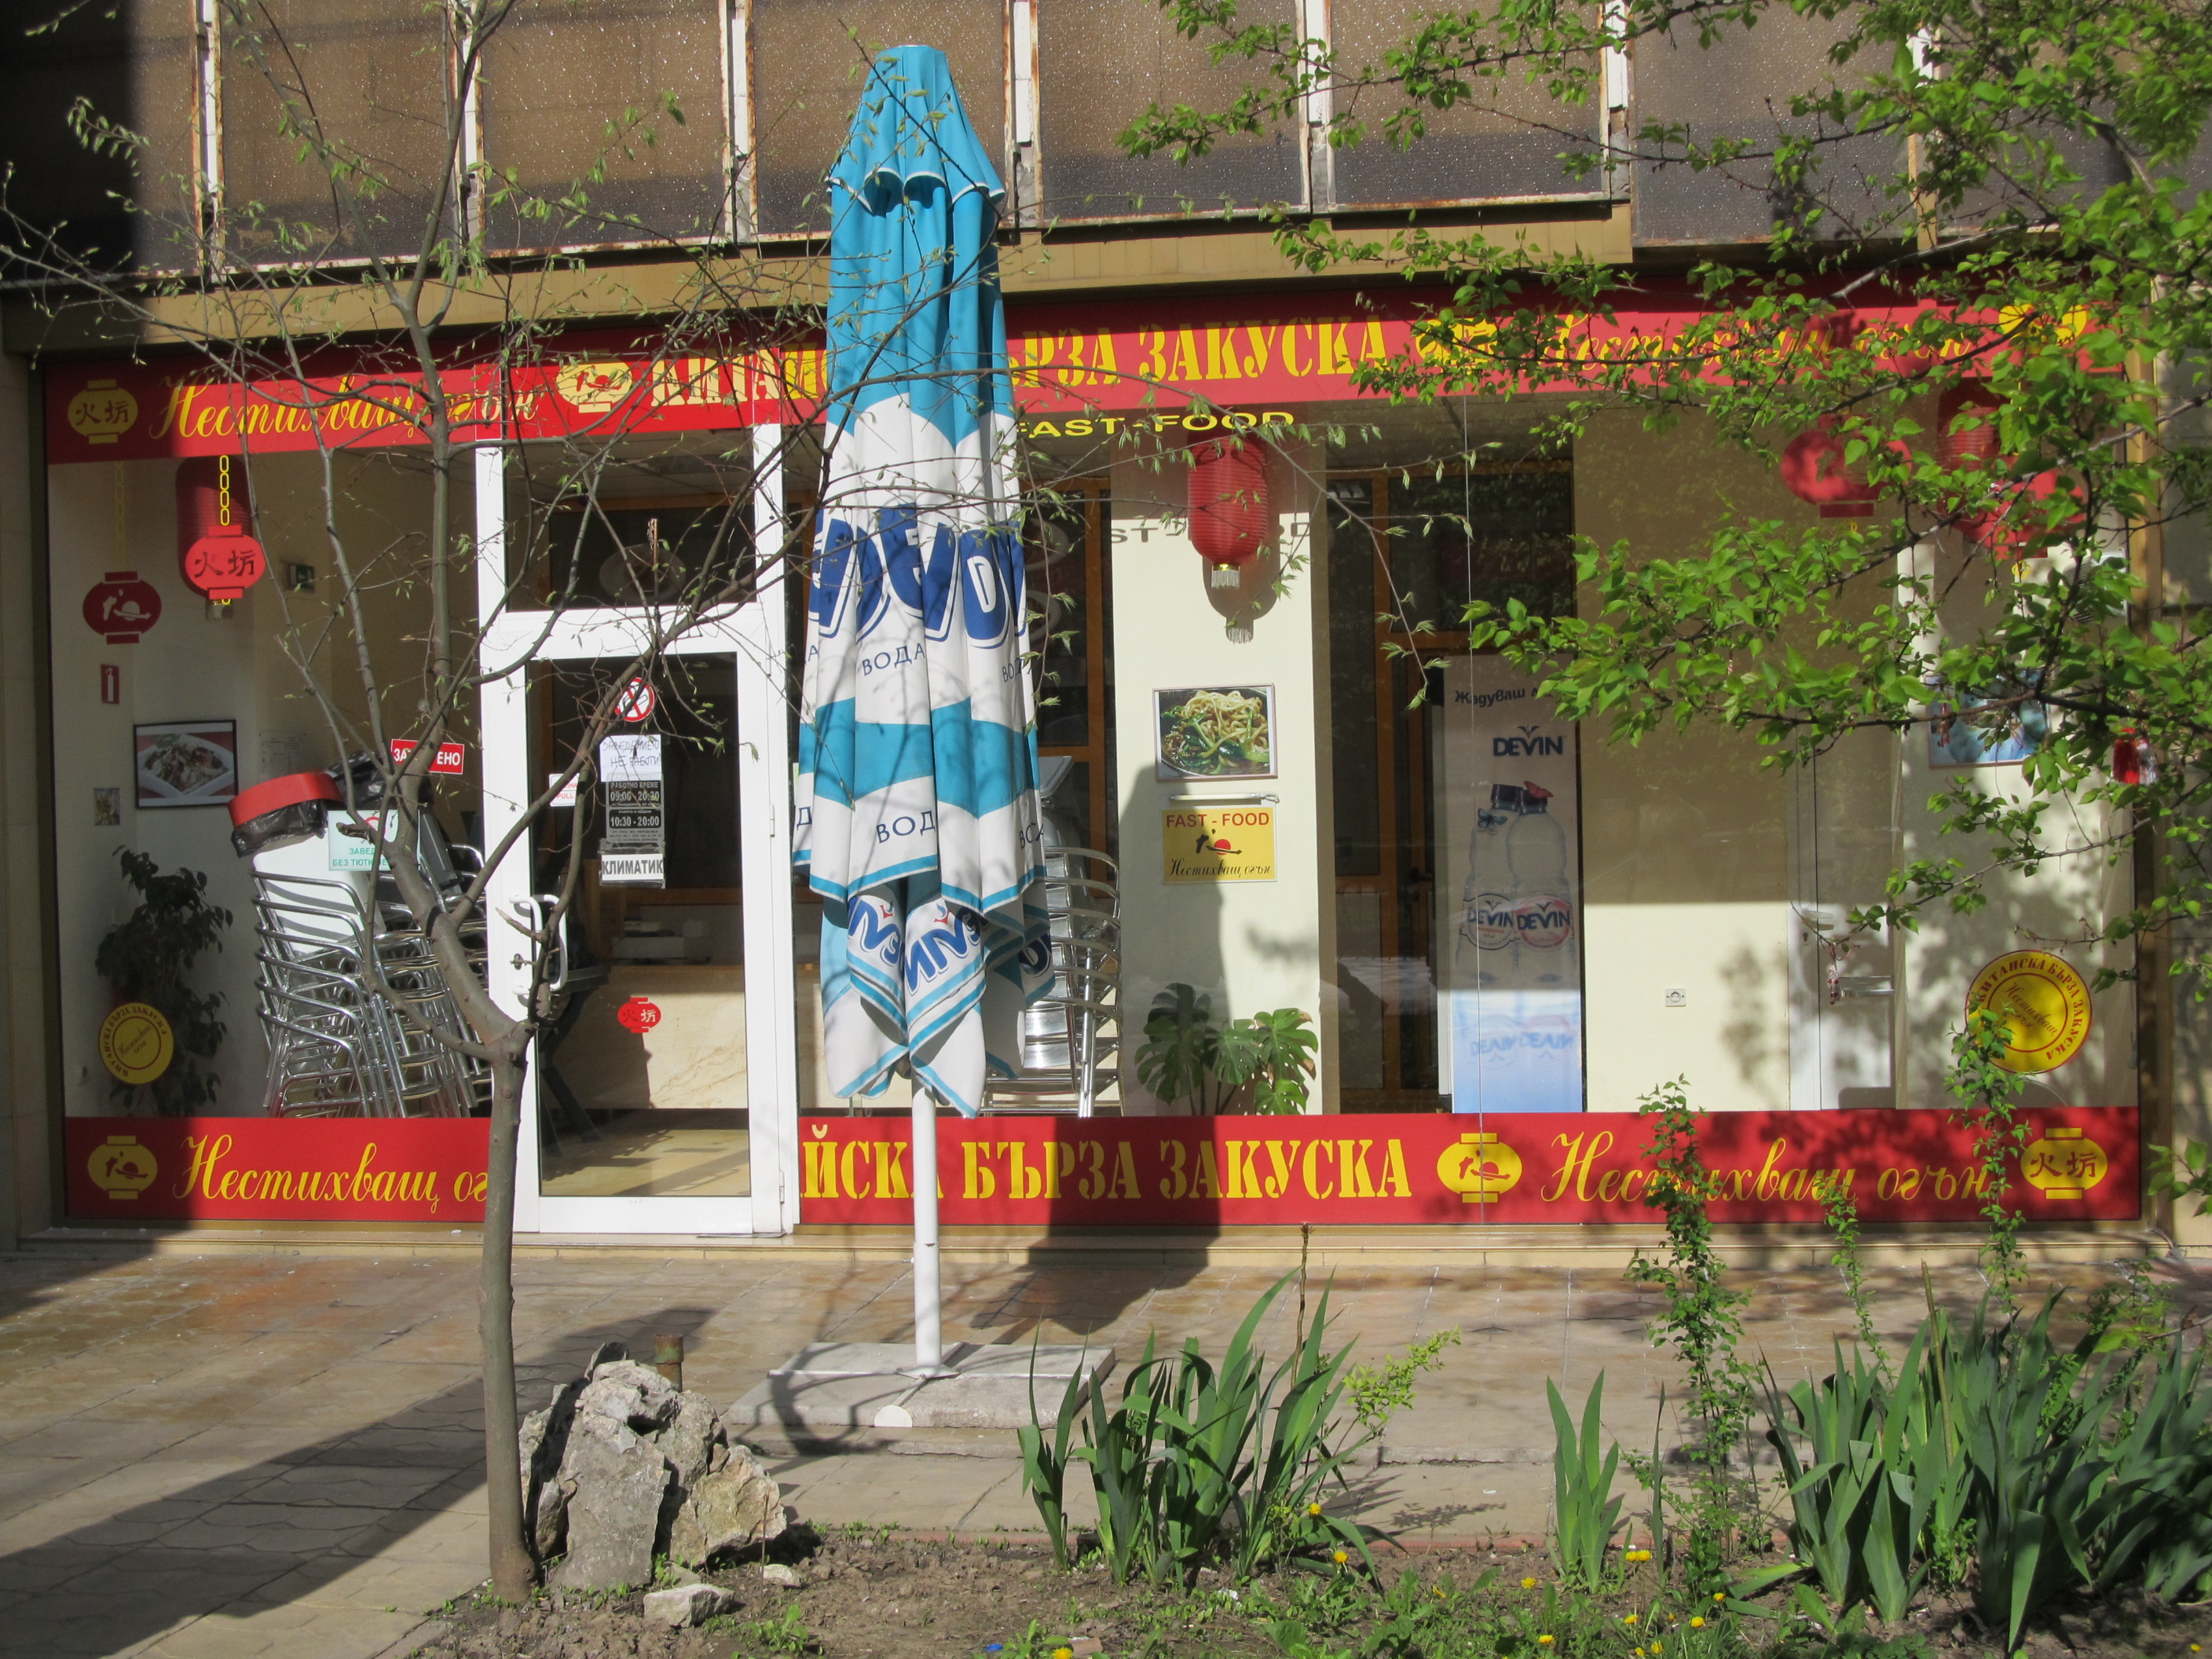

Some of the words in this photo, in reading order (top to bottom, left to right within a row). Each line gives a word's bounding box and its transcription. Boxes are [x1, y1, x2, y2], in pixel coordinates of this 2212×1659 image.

[650, 327, 829, 407] КИТАЙ
[1009, 327, 1121, 388] РЗА
[1138, 314, 1393, 383] ЗАКУСКА
[861, 643, 926, 677] ВОДА
[1454, 687, 1525, 708] Жадуваш
[1493, 735, 1563, 756] DEVIN
[394, 748, 461, 767] ЗАЕНО
[610, 755, 627, 768] НЕ
[610, 790, 632, 801] 09:00
[610, 816, 632, 827] 10:30
[637, 815, 660, 826] 20:00
[875, 810, 936, 844] ВОД
[1166, 814, 1207, 828] FAST
[1222, 812, 1269, 826] FOOD
[349, 847, 376, 855] ЗАВЕД
[602, 859, 664, 875] КЛИМАТИК
[1169, 858, 1242, 878] Нестихващ
[1244, 864, 1271, 875] огън
[1467, 906, 1513, 928] DEVIN
[1517, 910, 1571, 931] DEVIN
[2047, 962, 2080, 998] БЪРЗА
[2045, 999, 2084, 1060] ЗАКУСКА
[800, 1124, 944, 1199] ЙСК
[961, 1140, 1142, 1200] БЪРЗА
[1159, 1138, 1413, 1200] ЗАКУСКА
[173, 1133, 441, 1214] Нестихващ
[453, 1170, 489, 1202] ог
[1877, 1165, 1988, 1201] огън
